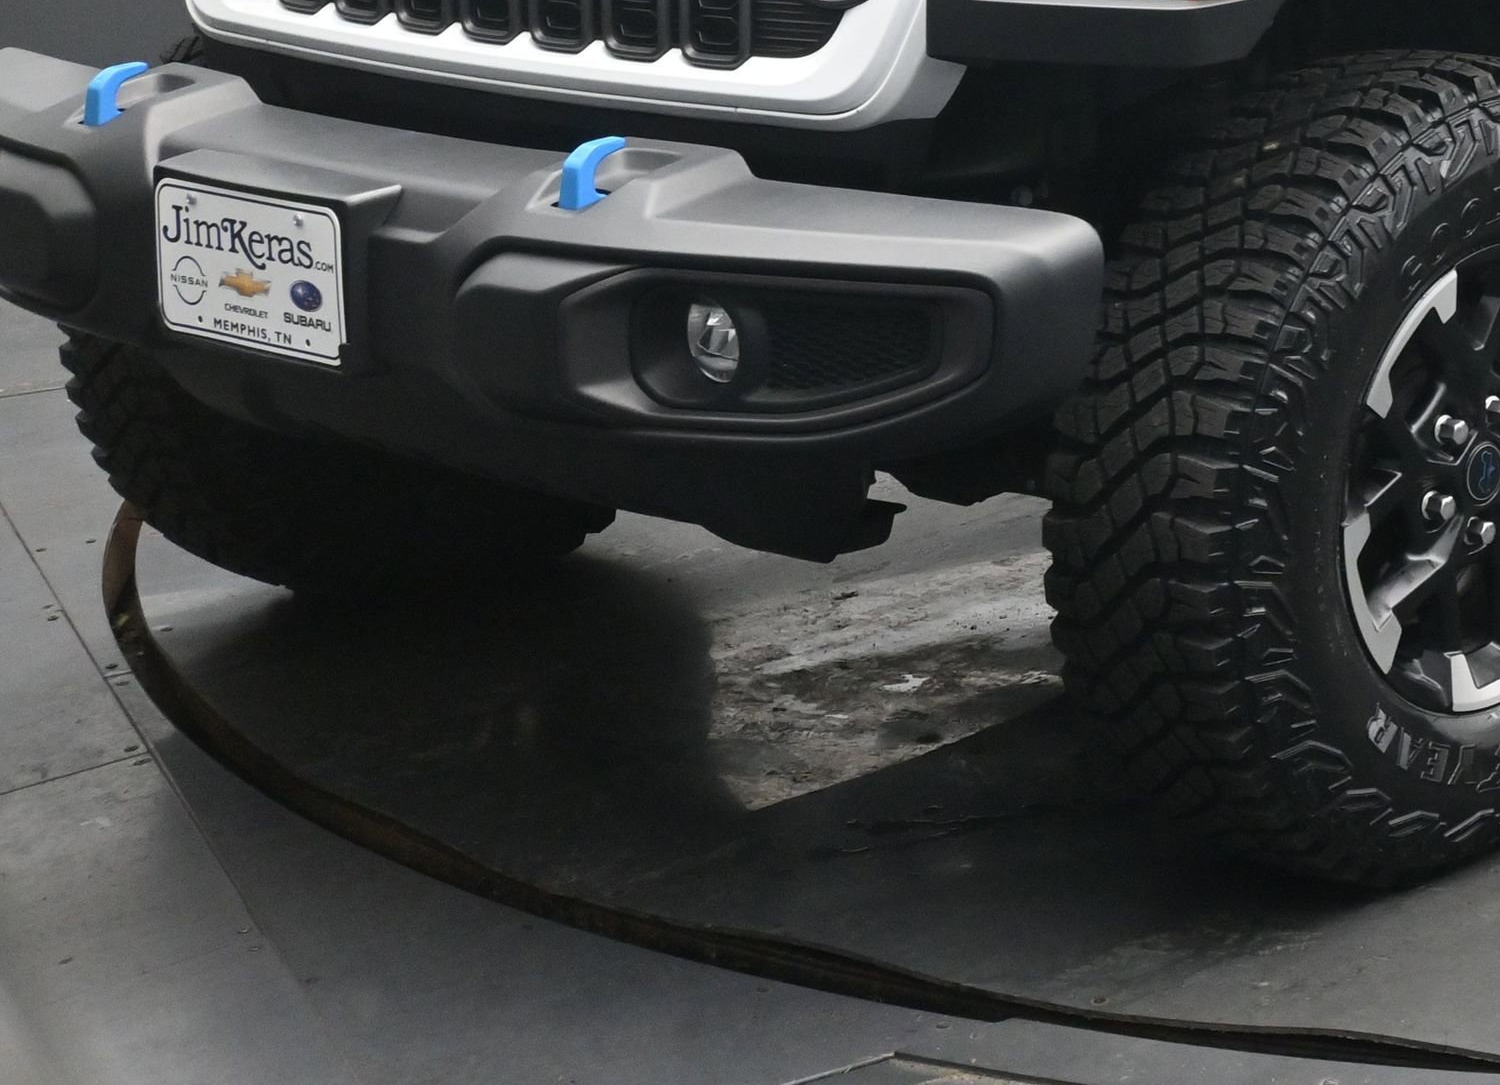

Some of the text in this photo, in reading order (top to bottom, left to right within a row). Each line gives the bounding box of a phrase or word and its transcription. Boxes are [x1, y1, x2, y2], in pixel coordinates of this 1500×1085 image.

[170, 274, 208, 287] NISSAN
[224, 303, 268, 319] CHEVROLET
[283, 312, 331, 332] SUBARU
[213, 318, 292, 345] MEMPHIS, TN
